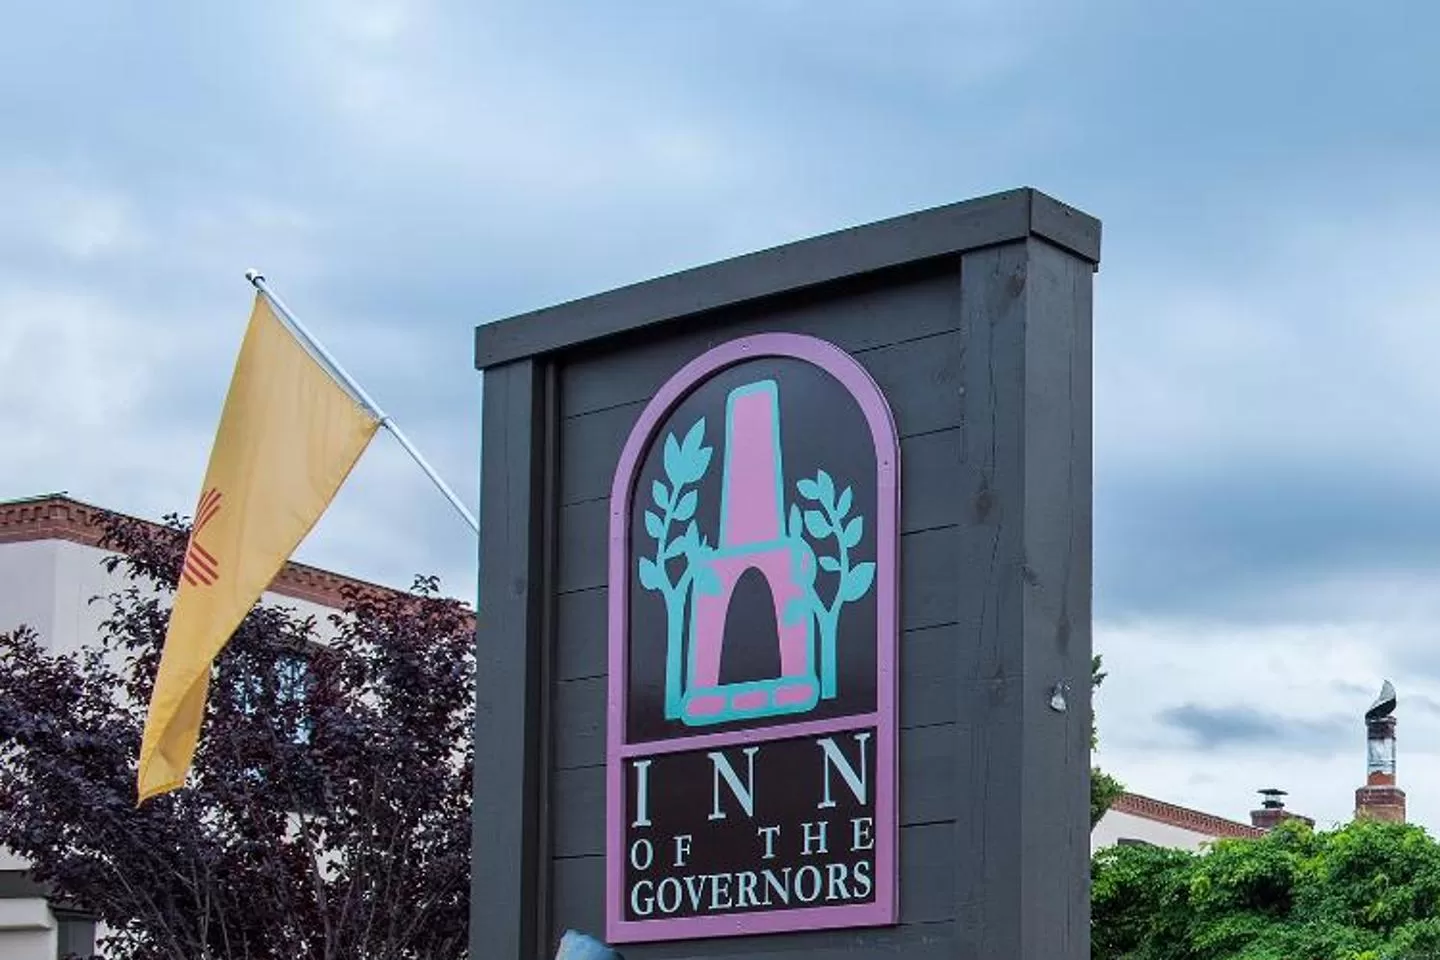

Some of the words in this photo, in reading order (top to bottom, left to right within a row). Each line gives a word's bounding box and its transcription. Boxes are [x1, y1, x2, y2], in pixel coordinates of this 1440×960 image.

[631, 835, 692, 870] OF
[758, 817, 874, 859] THE
[631, 861, 872, 915] GOVERNORS
